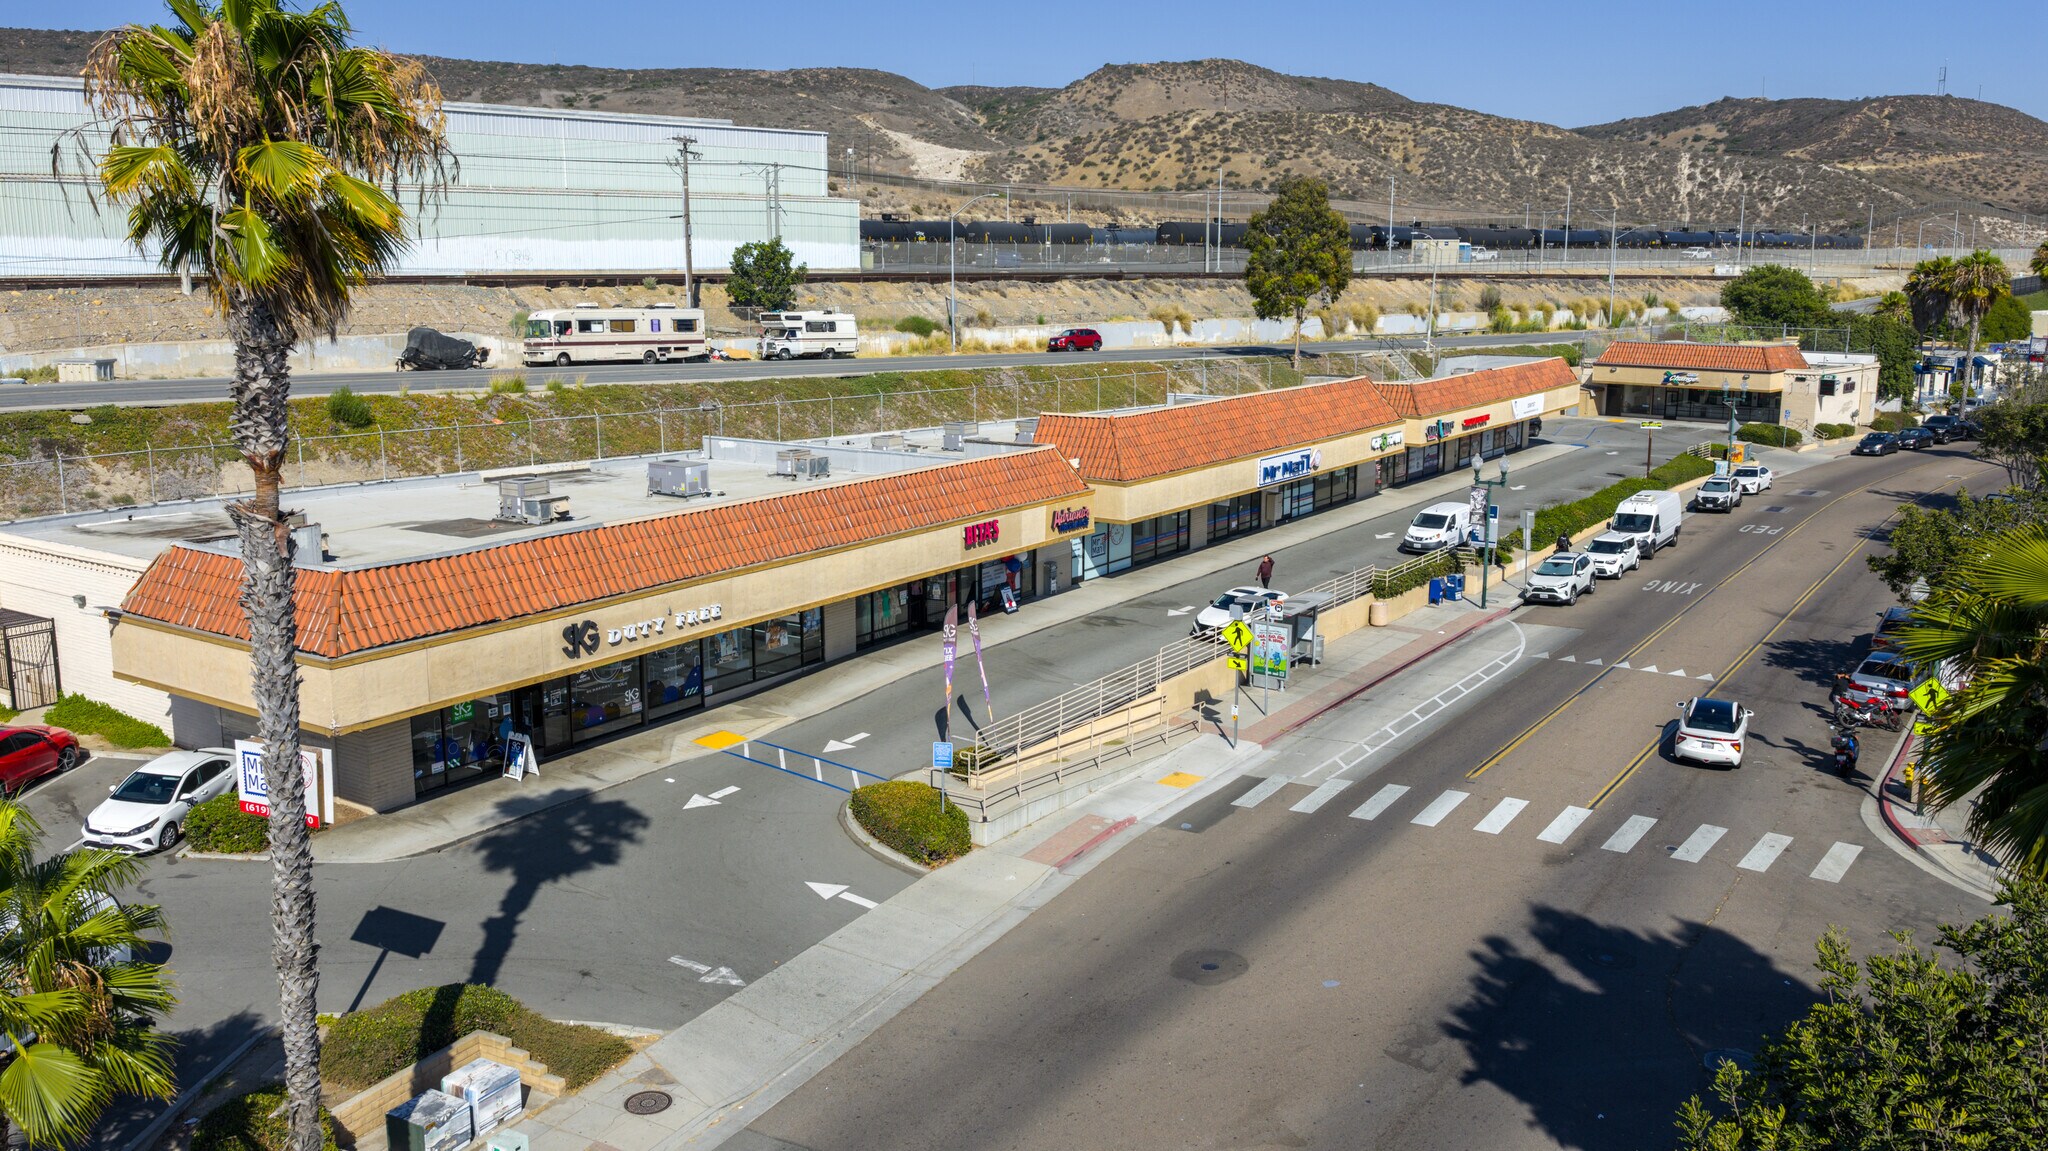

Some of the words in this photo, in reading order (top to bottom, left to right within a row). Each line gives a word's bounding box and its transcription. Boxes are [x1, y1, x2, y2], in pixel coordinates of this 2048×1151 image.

[1263, 465, 1281, 481] Mr
[1282, 454, 1310, 477] Mail
[1738, 524, 1784, 535] PED
[1642, 579, 1703, 595] XING
[562, 619, 600, 659] SKG
[607, 617, 665, 647] DUTY
[675, 603, 721, 630] FREE
[625, 688, 639, 702] SKG
[248, 774, 268, 791] Ma
[245, 803, 270, 815] (619)
